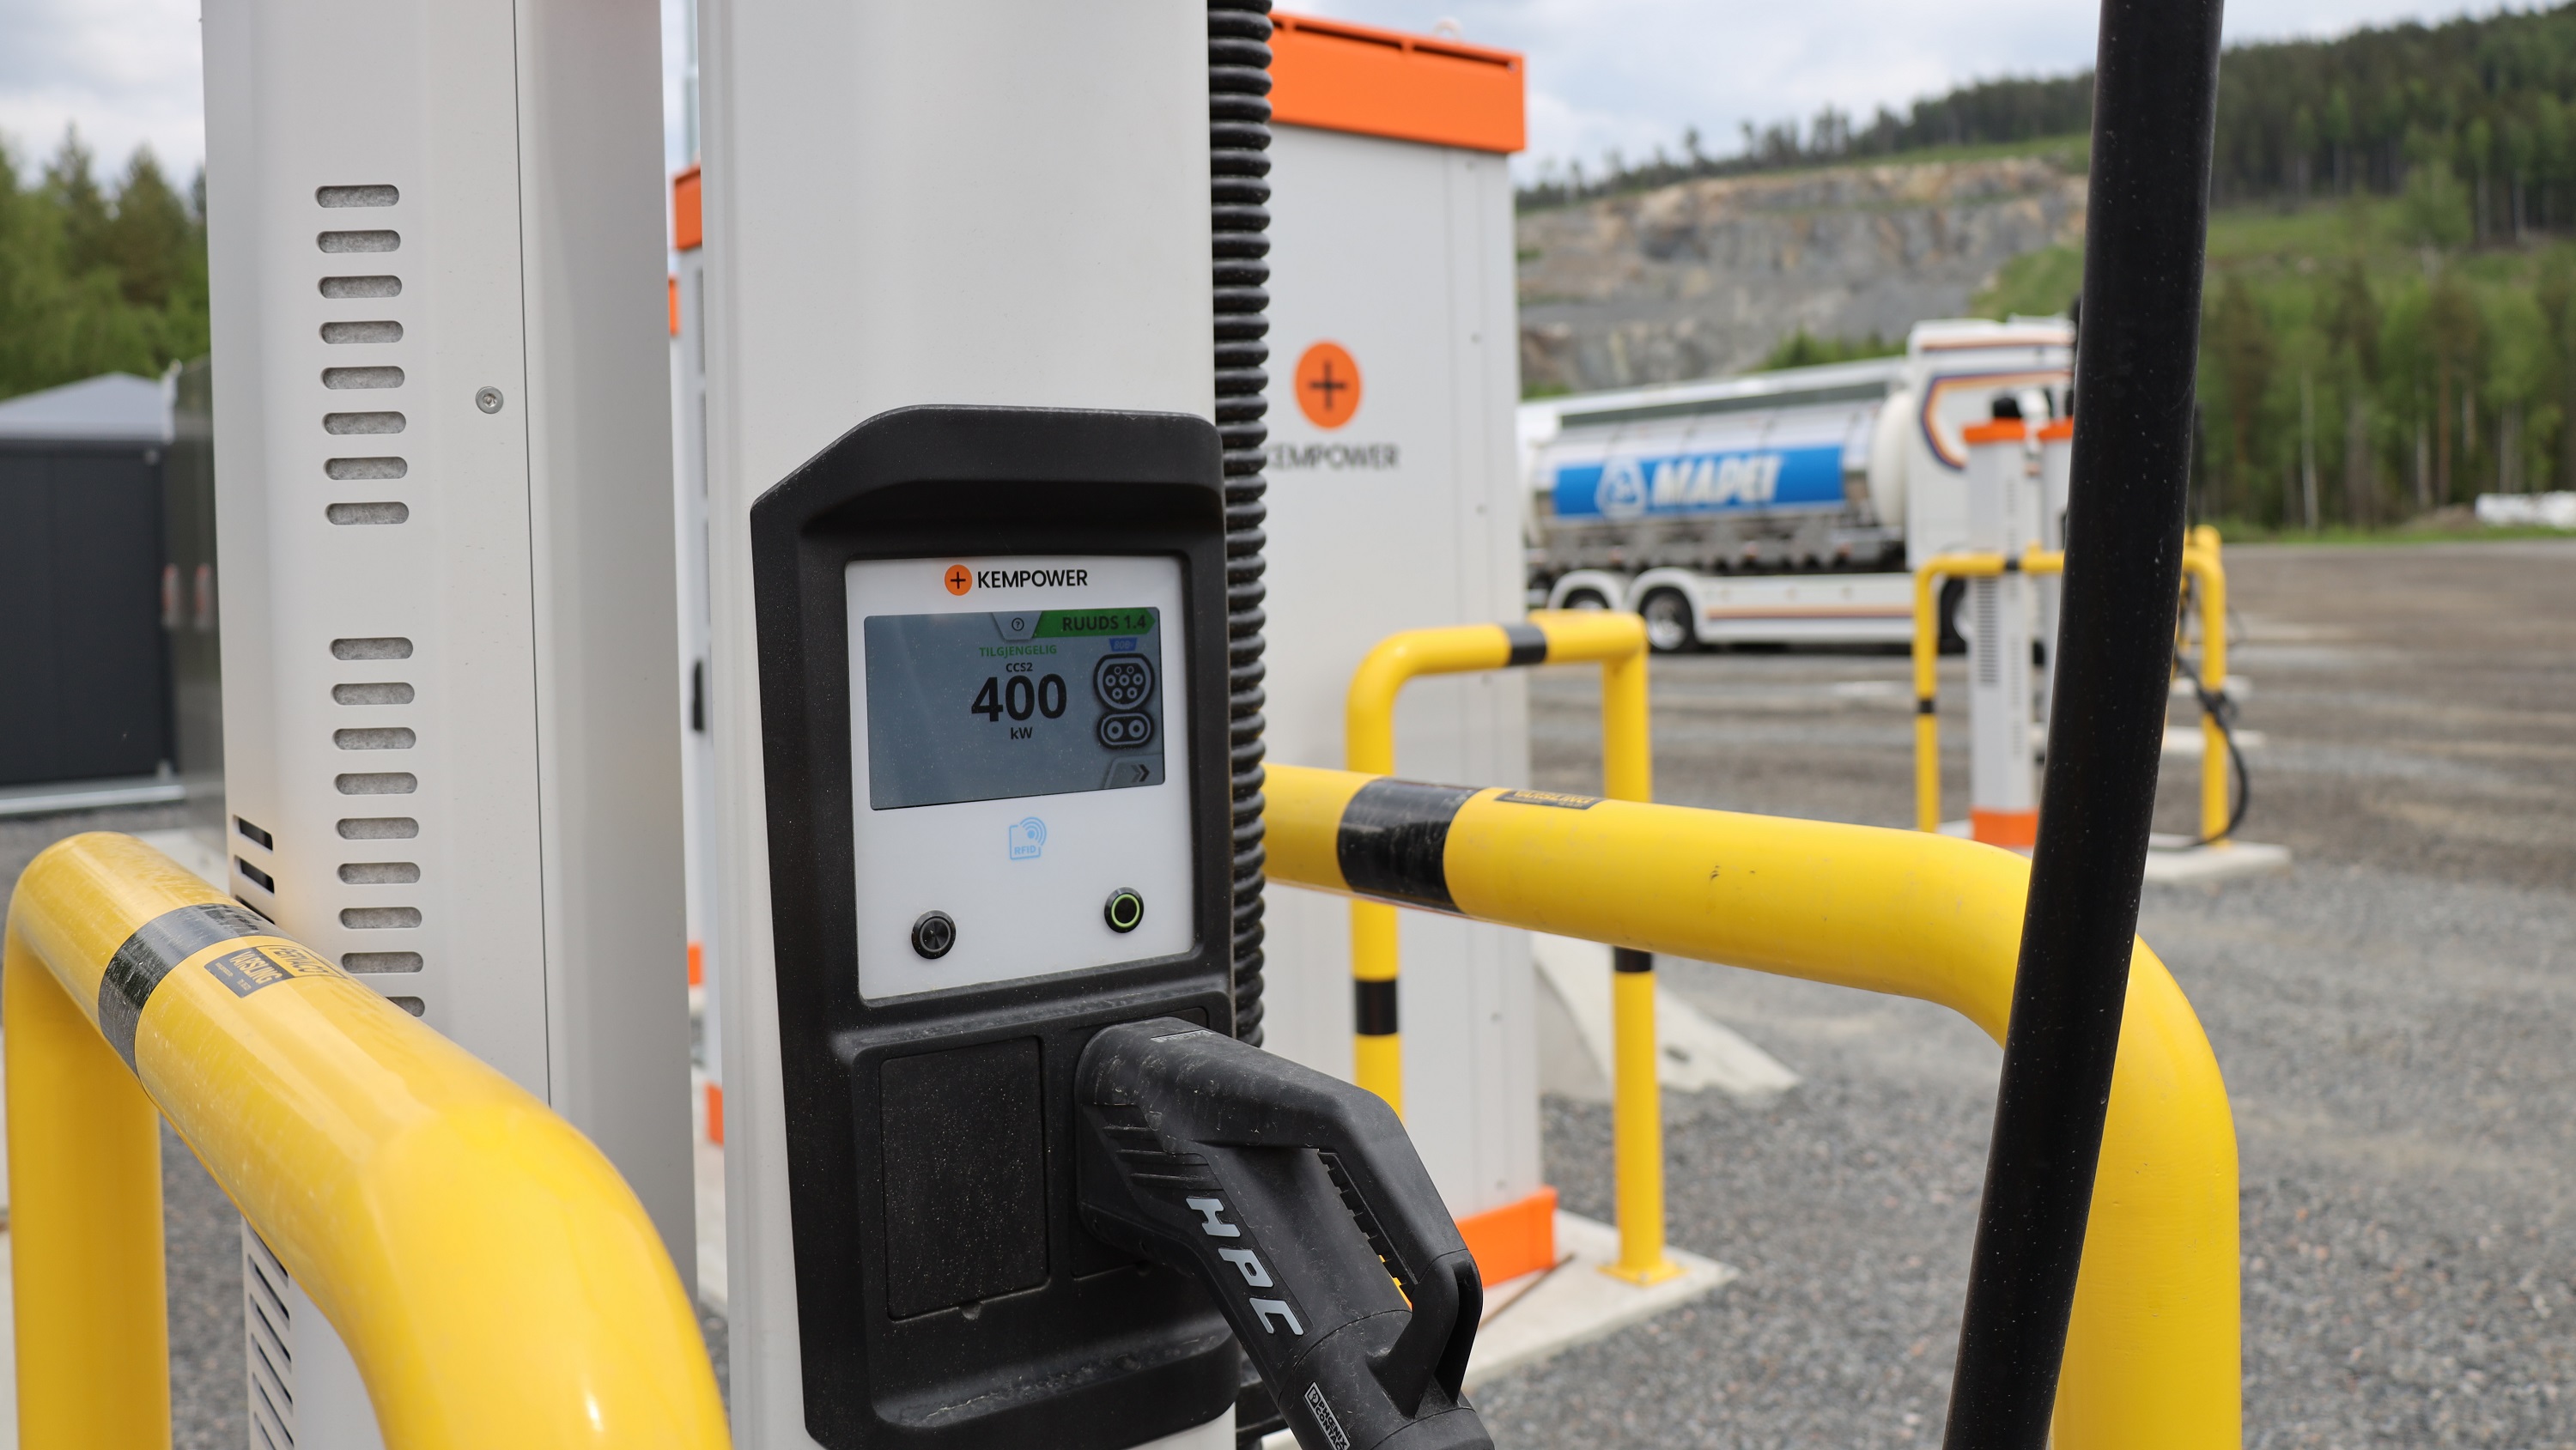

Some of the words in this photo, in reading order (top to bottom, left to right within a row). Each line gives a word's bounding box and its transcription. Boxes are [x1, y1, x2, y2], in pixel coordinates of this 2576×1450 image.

[1267, 442, 1400, 469] EMPOWER
[1652, 454, 1783, 507] MAPEI
[977, 569, 1088, 589] KEMPOWER
[1062, 616, 1119, 631] RUUDS
[1124, 615, 1147, 629] 1.4
[979, 644, 1057, 658] TILGJENGELIG
[1005, 662, 1033, 673] CCS2
[971, 673, 1067, 722] 400
[1010, 726, 1033, 740] kW
[1014, 845, 1036, 855] RFID
[228, 950, 283, 985] VARSLING
[1186, 1196, 1304, 1337] HPC
[1315, 1407, 1343, 1450] CONTAC
